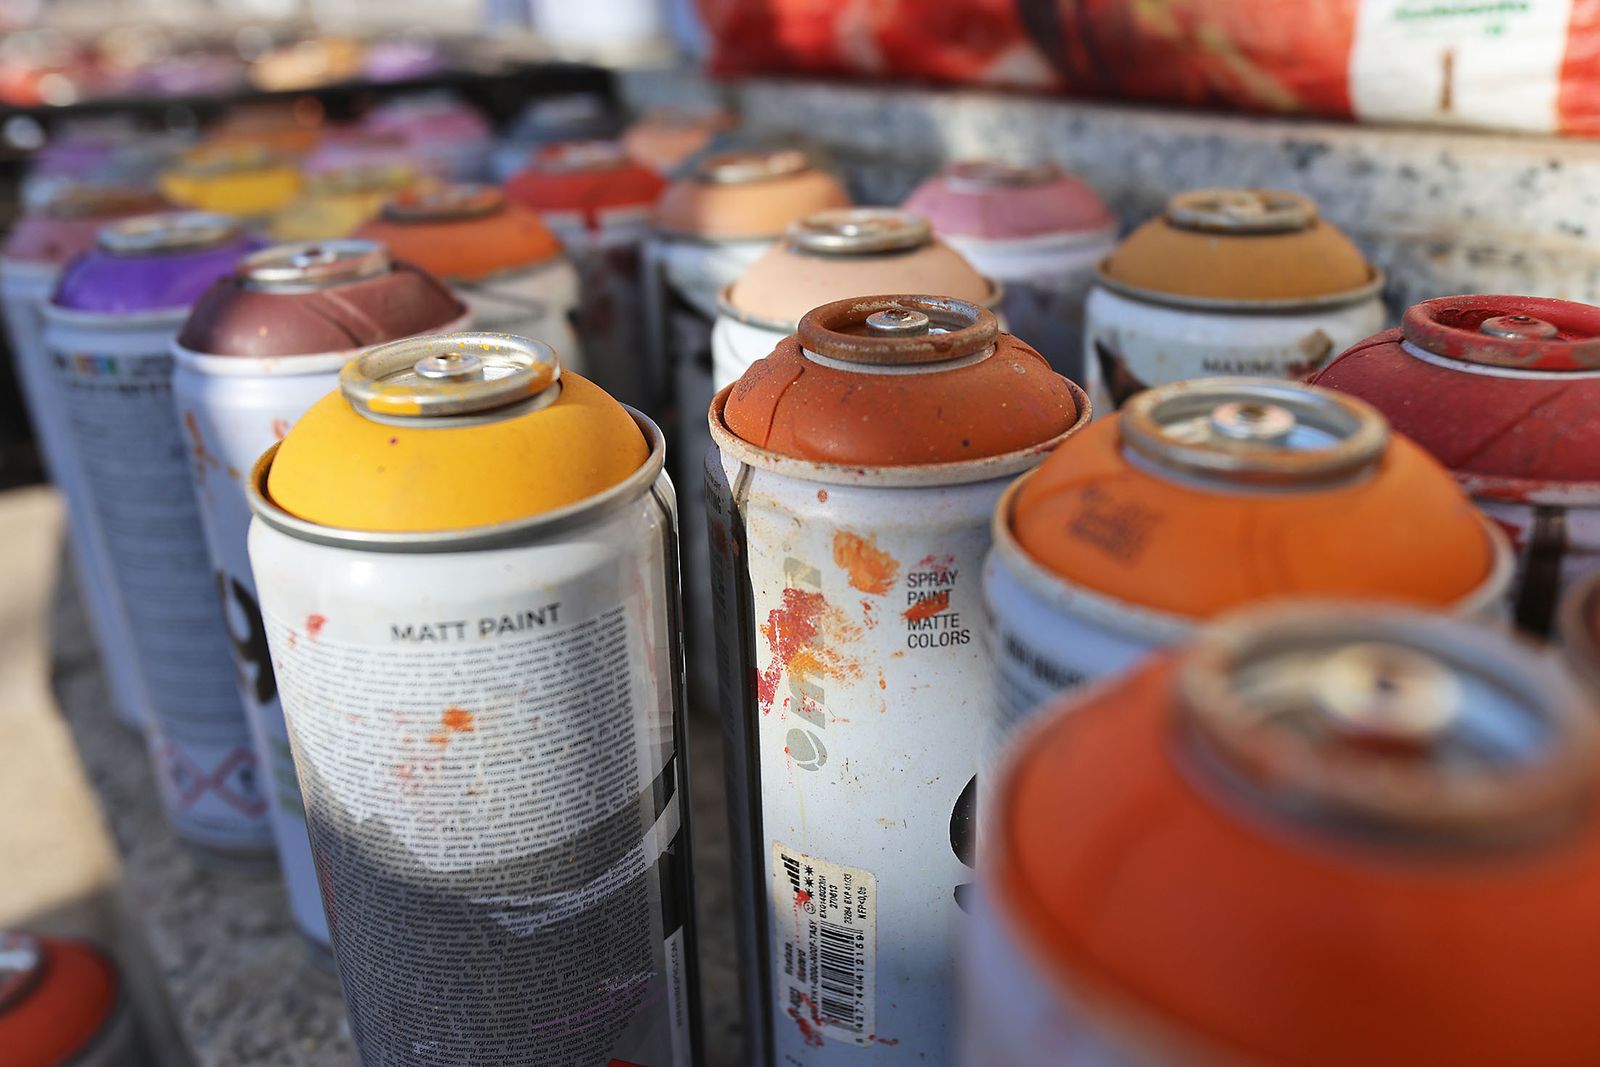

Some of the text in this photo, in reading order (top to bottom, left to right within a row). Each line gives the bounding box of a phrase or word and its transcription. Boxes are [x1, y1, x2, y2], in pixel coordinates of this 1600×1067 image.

[907, 569, 959, 588] SPRAY
[907, 589, 953, 606] PAINT
[390, 603, 562, 644] MATT PAINT
[907, 613, 960, 631] MATTE
[907, 630, 970, 649] COLORS
[843, 891, 853, 907] EXP
[563, 971, 579, 979] (PT)
